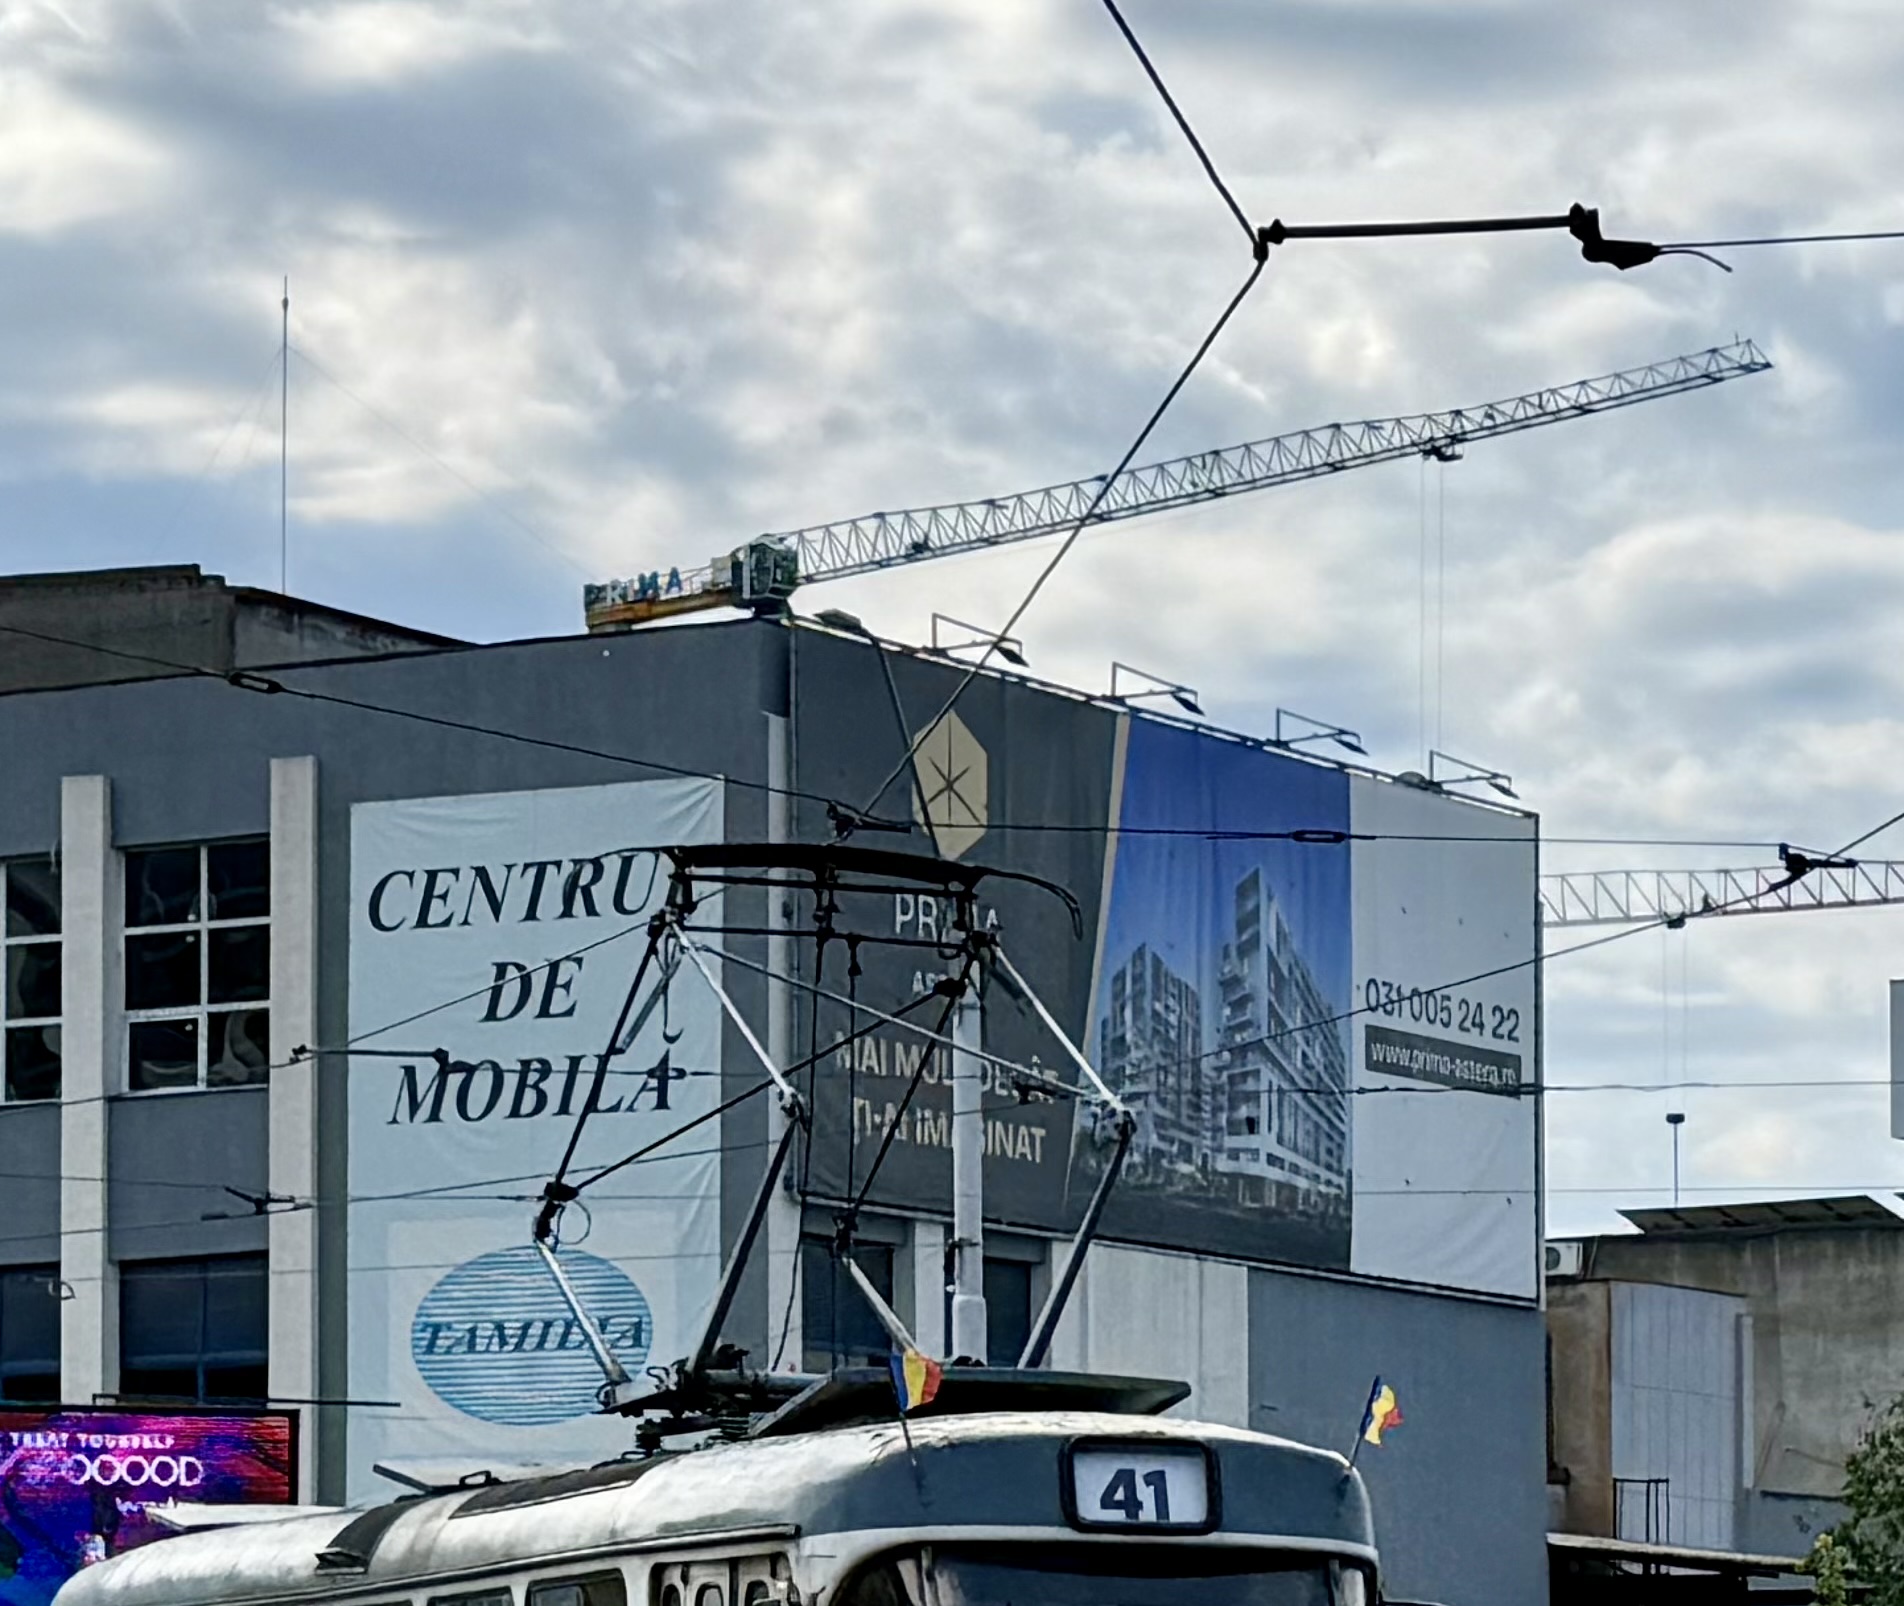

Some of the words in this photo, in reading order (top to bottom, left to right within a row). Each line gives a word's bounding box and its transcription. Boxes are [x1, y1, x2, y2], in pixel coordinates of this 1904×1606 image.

[366, 850, 662, 933] CENTRU
[478, 955, 584, 1024] DE
[1365, 978, 1403, 1018] 031
[1410, 988, 1452, 1028] 005
[1458, 999, 1485, 1036] 24
[1492, 1005, 1520, 1043] 22
[422, 1316, 644, 1354] TAMILA
[1099, 1469, 1170, 1521] 41
